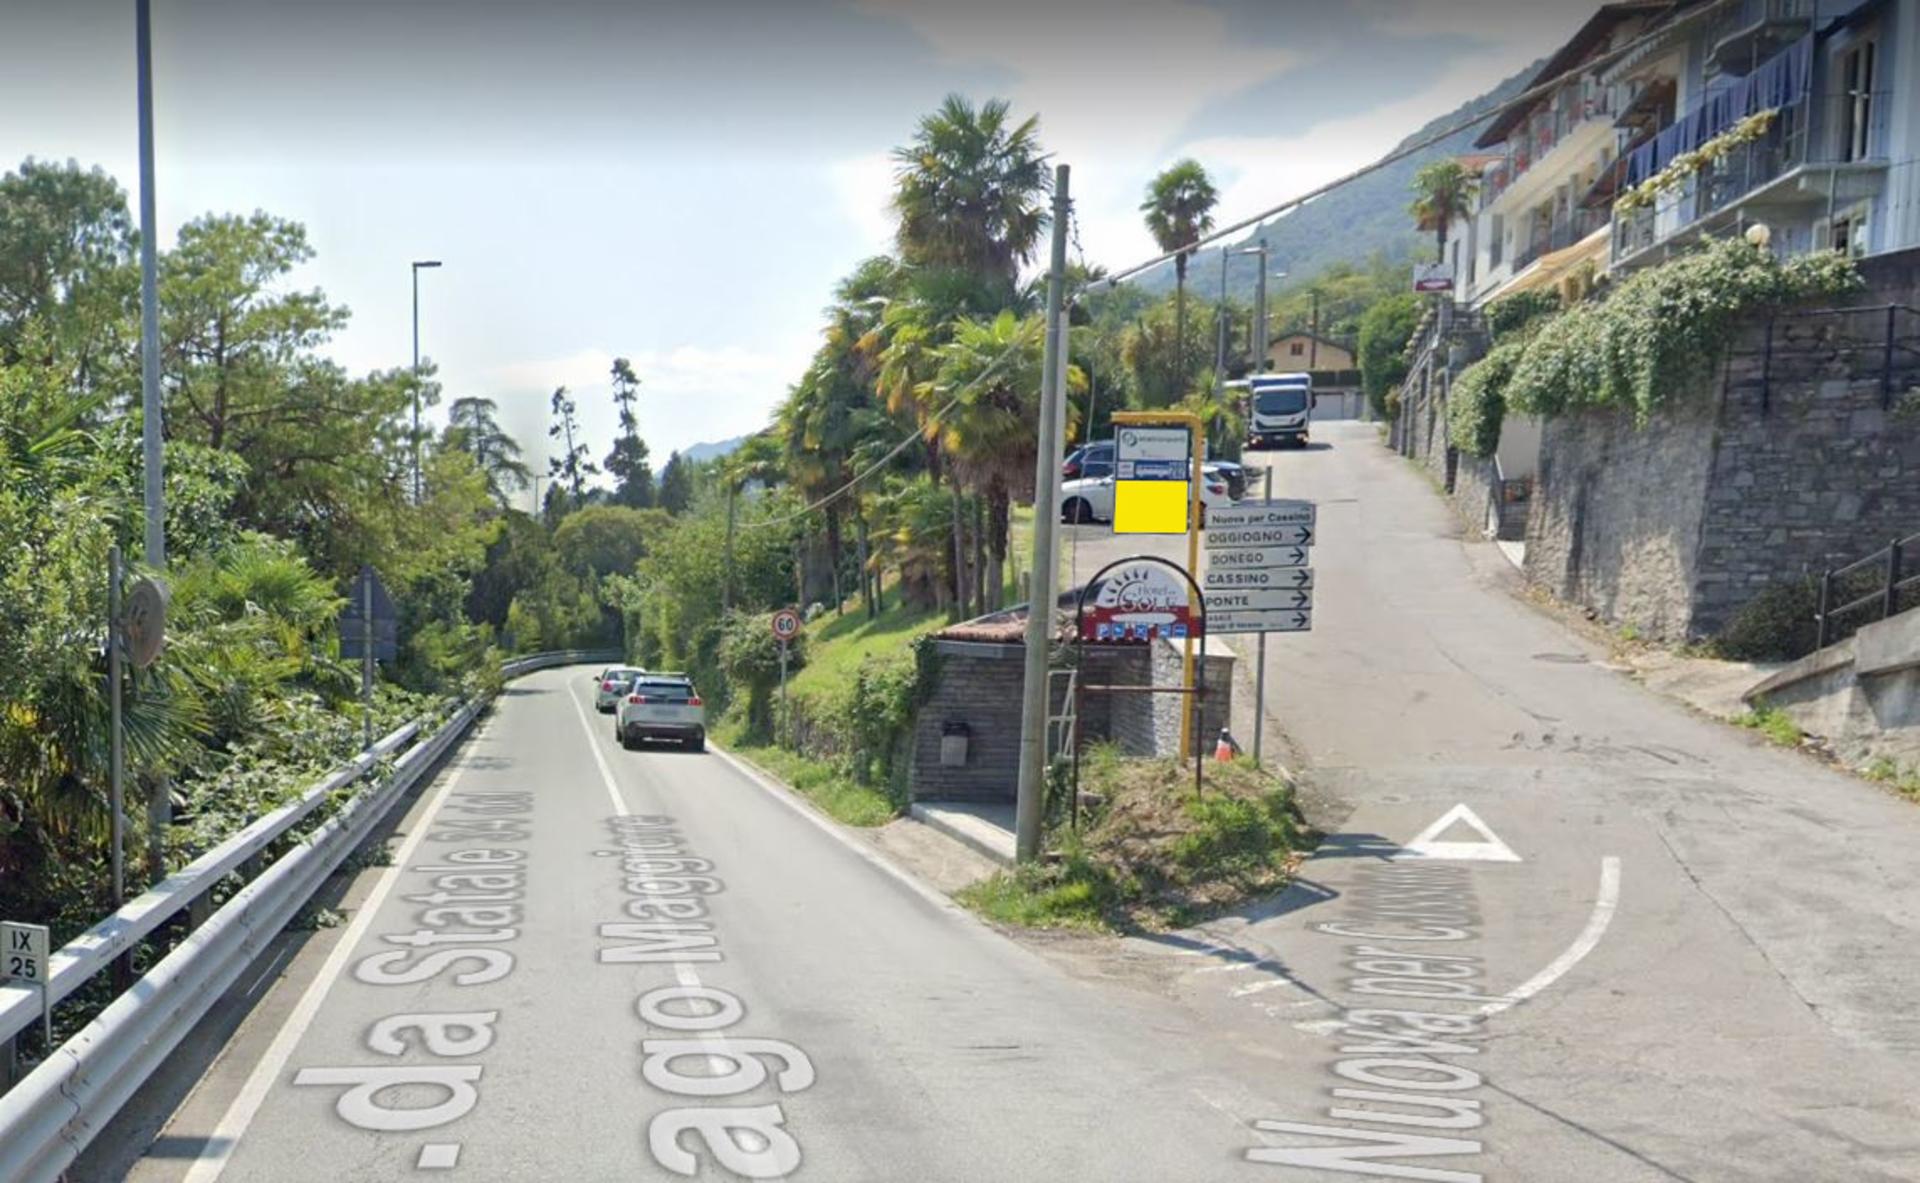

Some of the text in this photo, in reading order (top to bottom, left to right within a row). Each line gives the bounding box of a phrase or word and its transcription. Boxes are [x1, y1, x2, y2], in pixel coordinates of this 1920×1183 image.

[1212, 514, 1245, 524] Nuova
[1267, 512, 1311, 523] Cassino
[1208, 531, 1283, 544] OGGIOGNO
[1211, 553, 1264, 565] DONEGO
[1207, 574, 1269, 584] CASSINO
[1206, 595, 1249, 606] PONTE
[778, 618, 794, 631] 60
[12, 931, 31, 951] IX
[11, 957, 36, 978] 25
